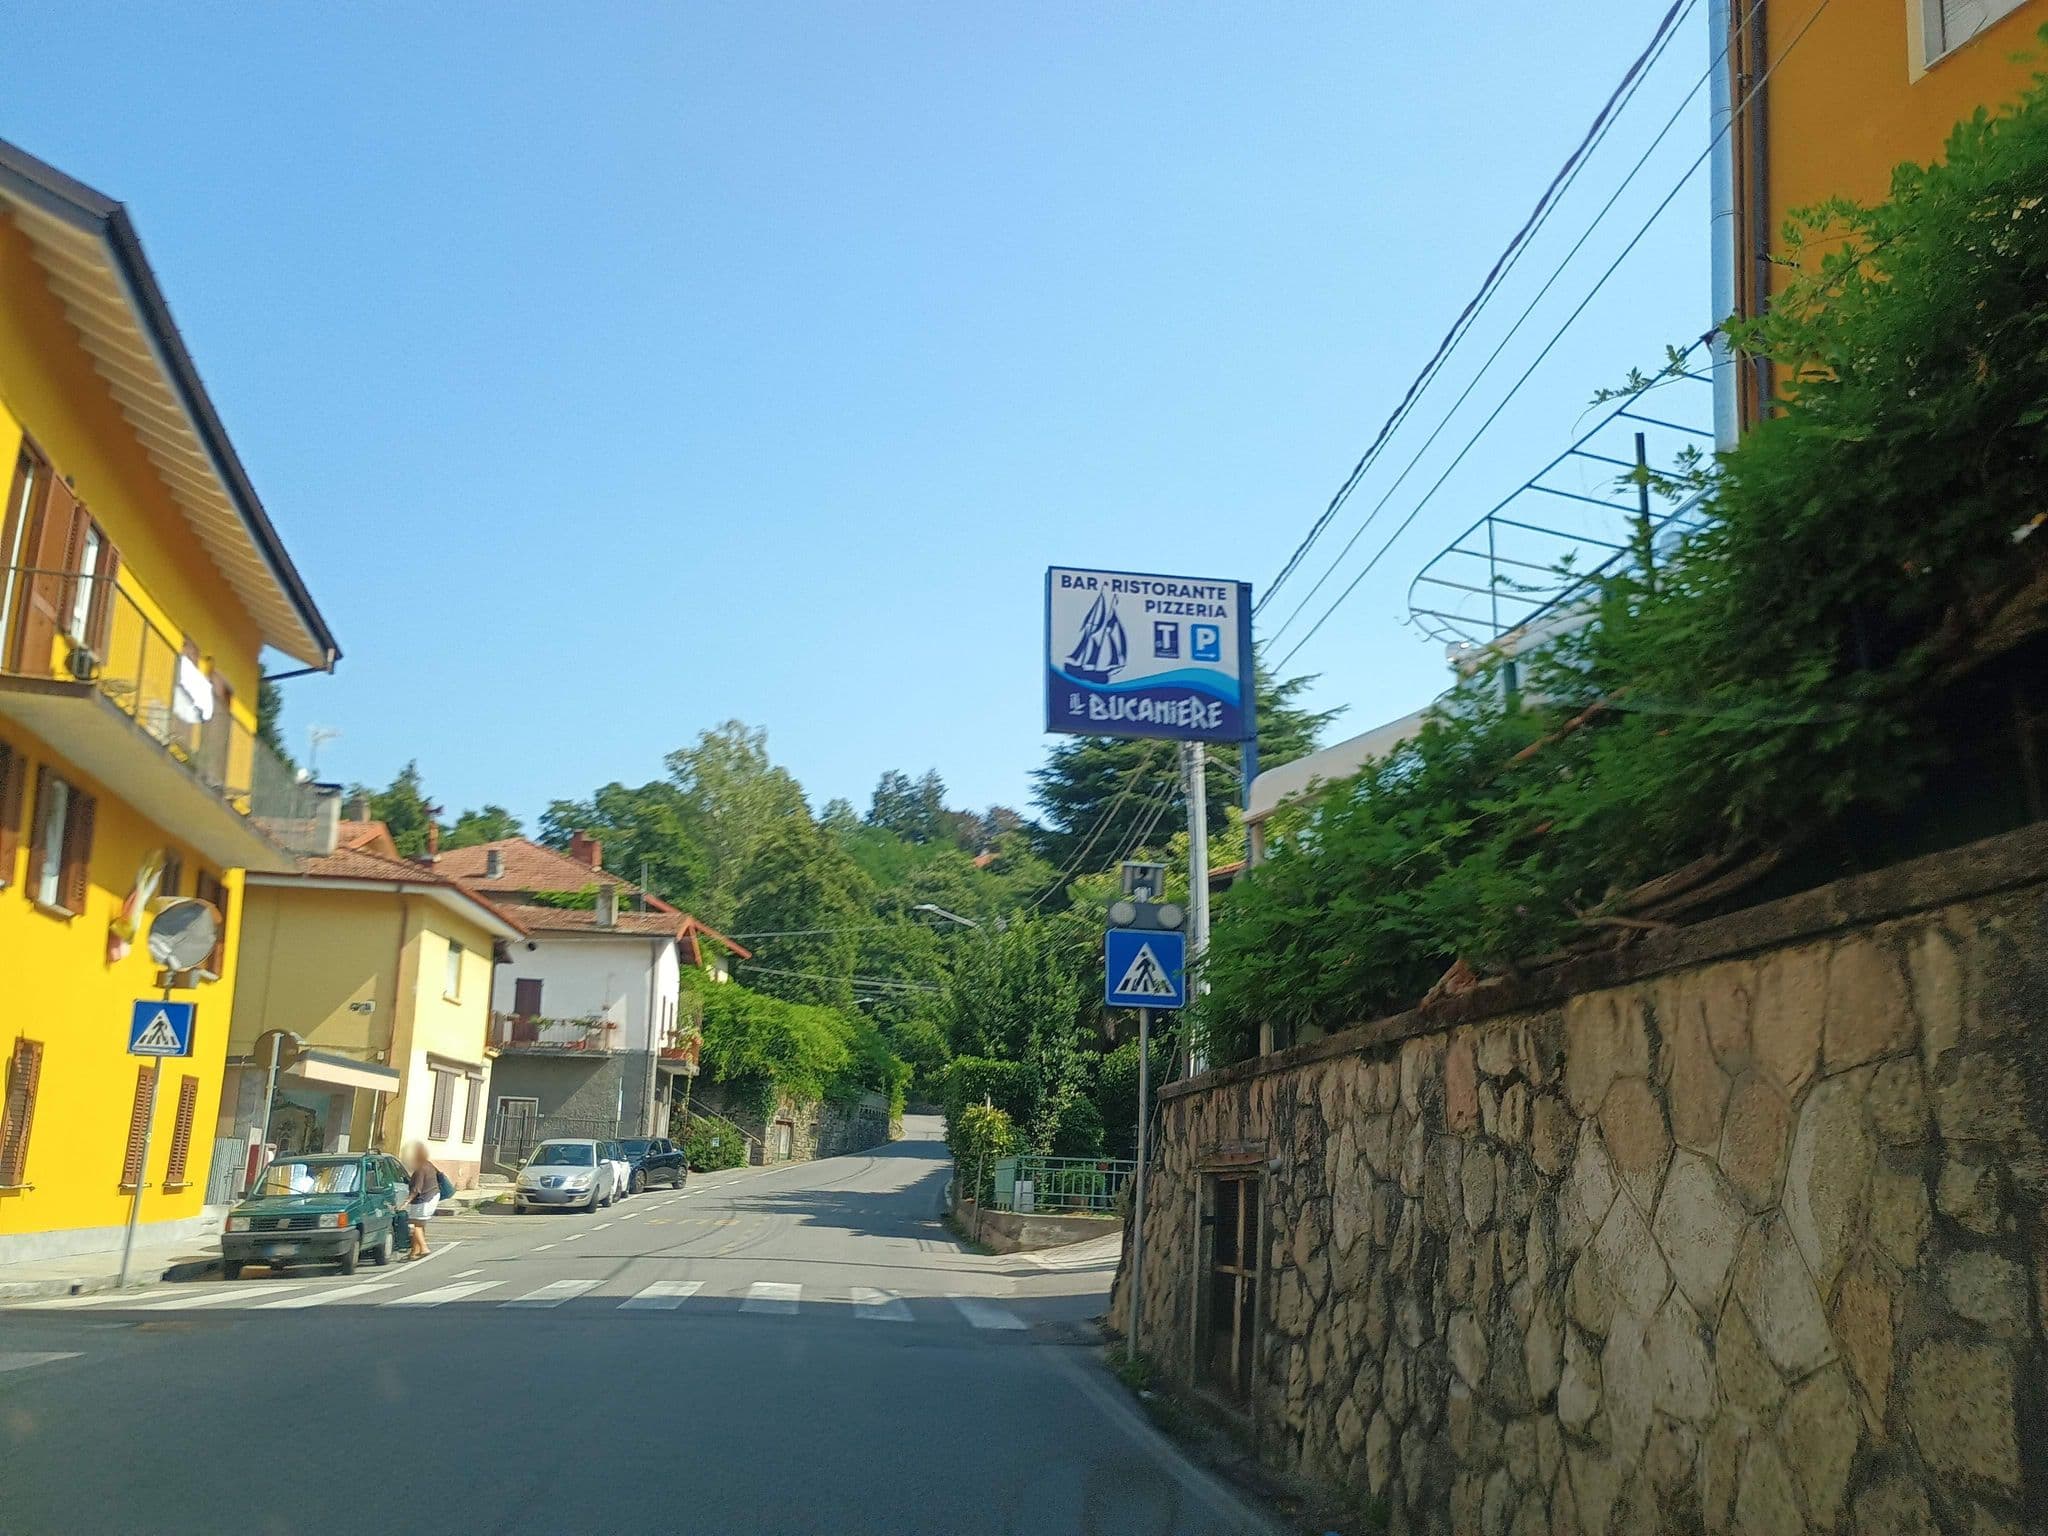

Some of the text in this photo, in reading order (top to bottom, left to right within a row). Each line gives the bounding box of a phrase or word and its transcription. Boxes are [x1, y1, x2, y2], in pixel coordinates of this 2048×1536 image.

[1061, 575, 1227, 601] BAR RISTORANTE
[1145, 599, 1228, 618] PIZZERIA
[1157, 625, 1176, 649] T
[1197, 628, 1217, 650] P
